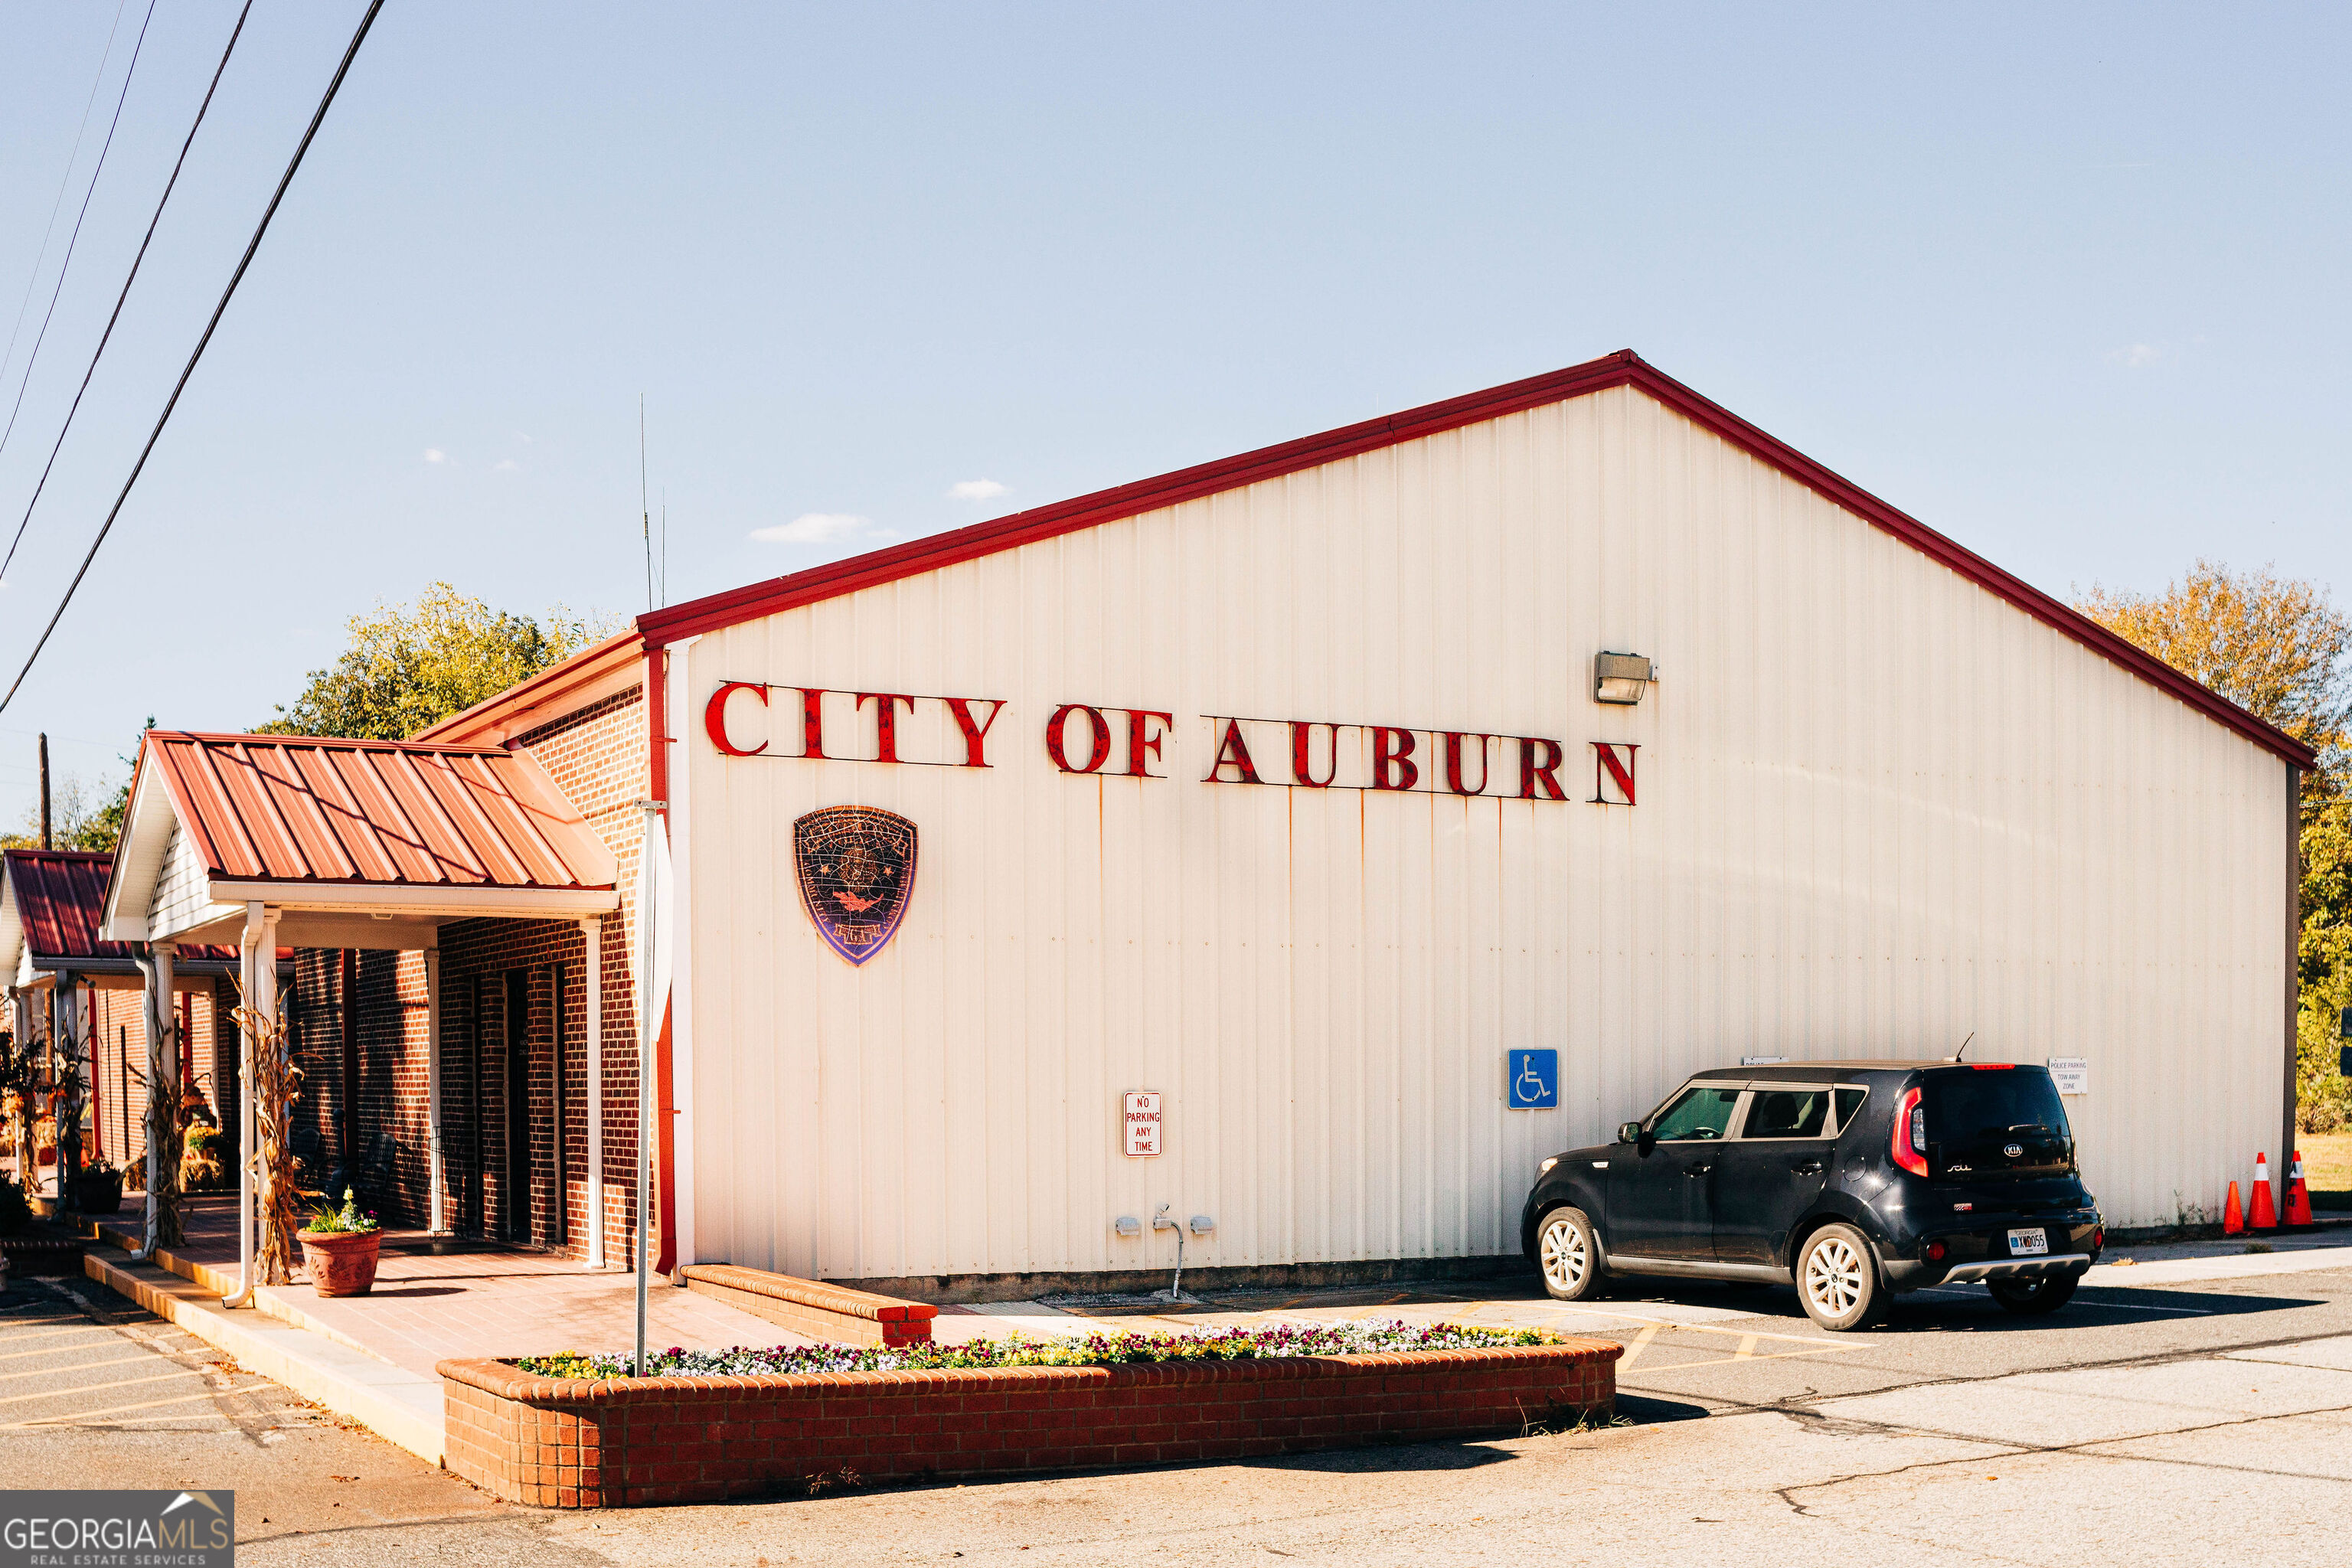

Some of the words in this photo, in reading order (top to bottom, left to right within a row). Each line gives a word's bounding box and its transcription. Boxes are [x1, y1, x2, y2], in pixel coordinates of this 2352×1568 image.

[705, 681, 1008, 768] CITY
[1047, 703, 1173, 779] OF
[1200, 715, 1642, 806] AUBURN
[1137, 1098, 1149, 1108] NO
[1127, 1112, 1160, 1122] PARKING
[1135, 1127, 1152, 1137] ANY
[1135, 1142, 1153, 1152] TIME
[2007, 1146, 2021, 1155] KIA
